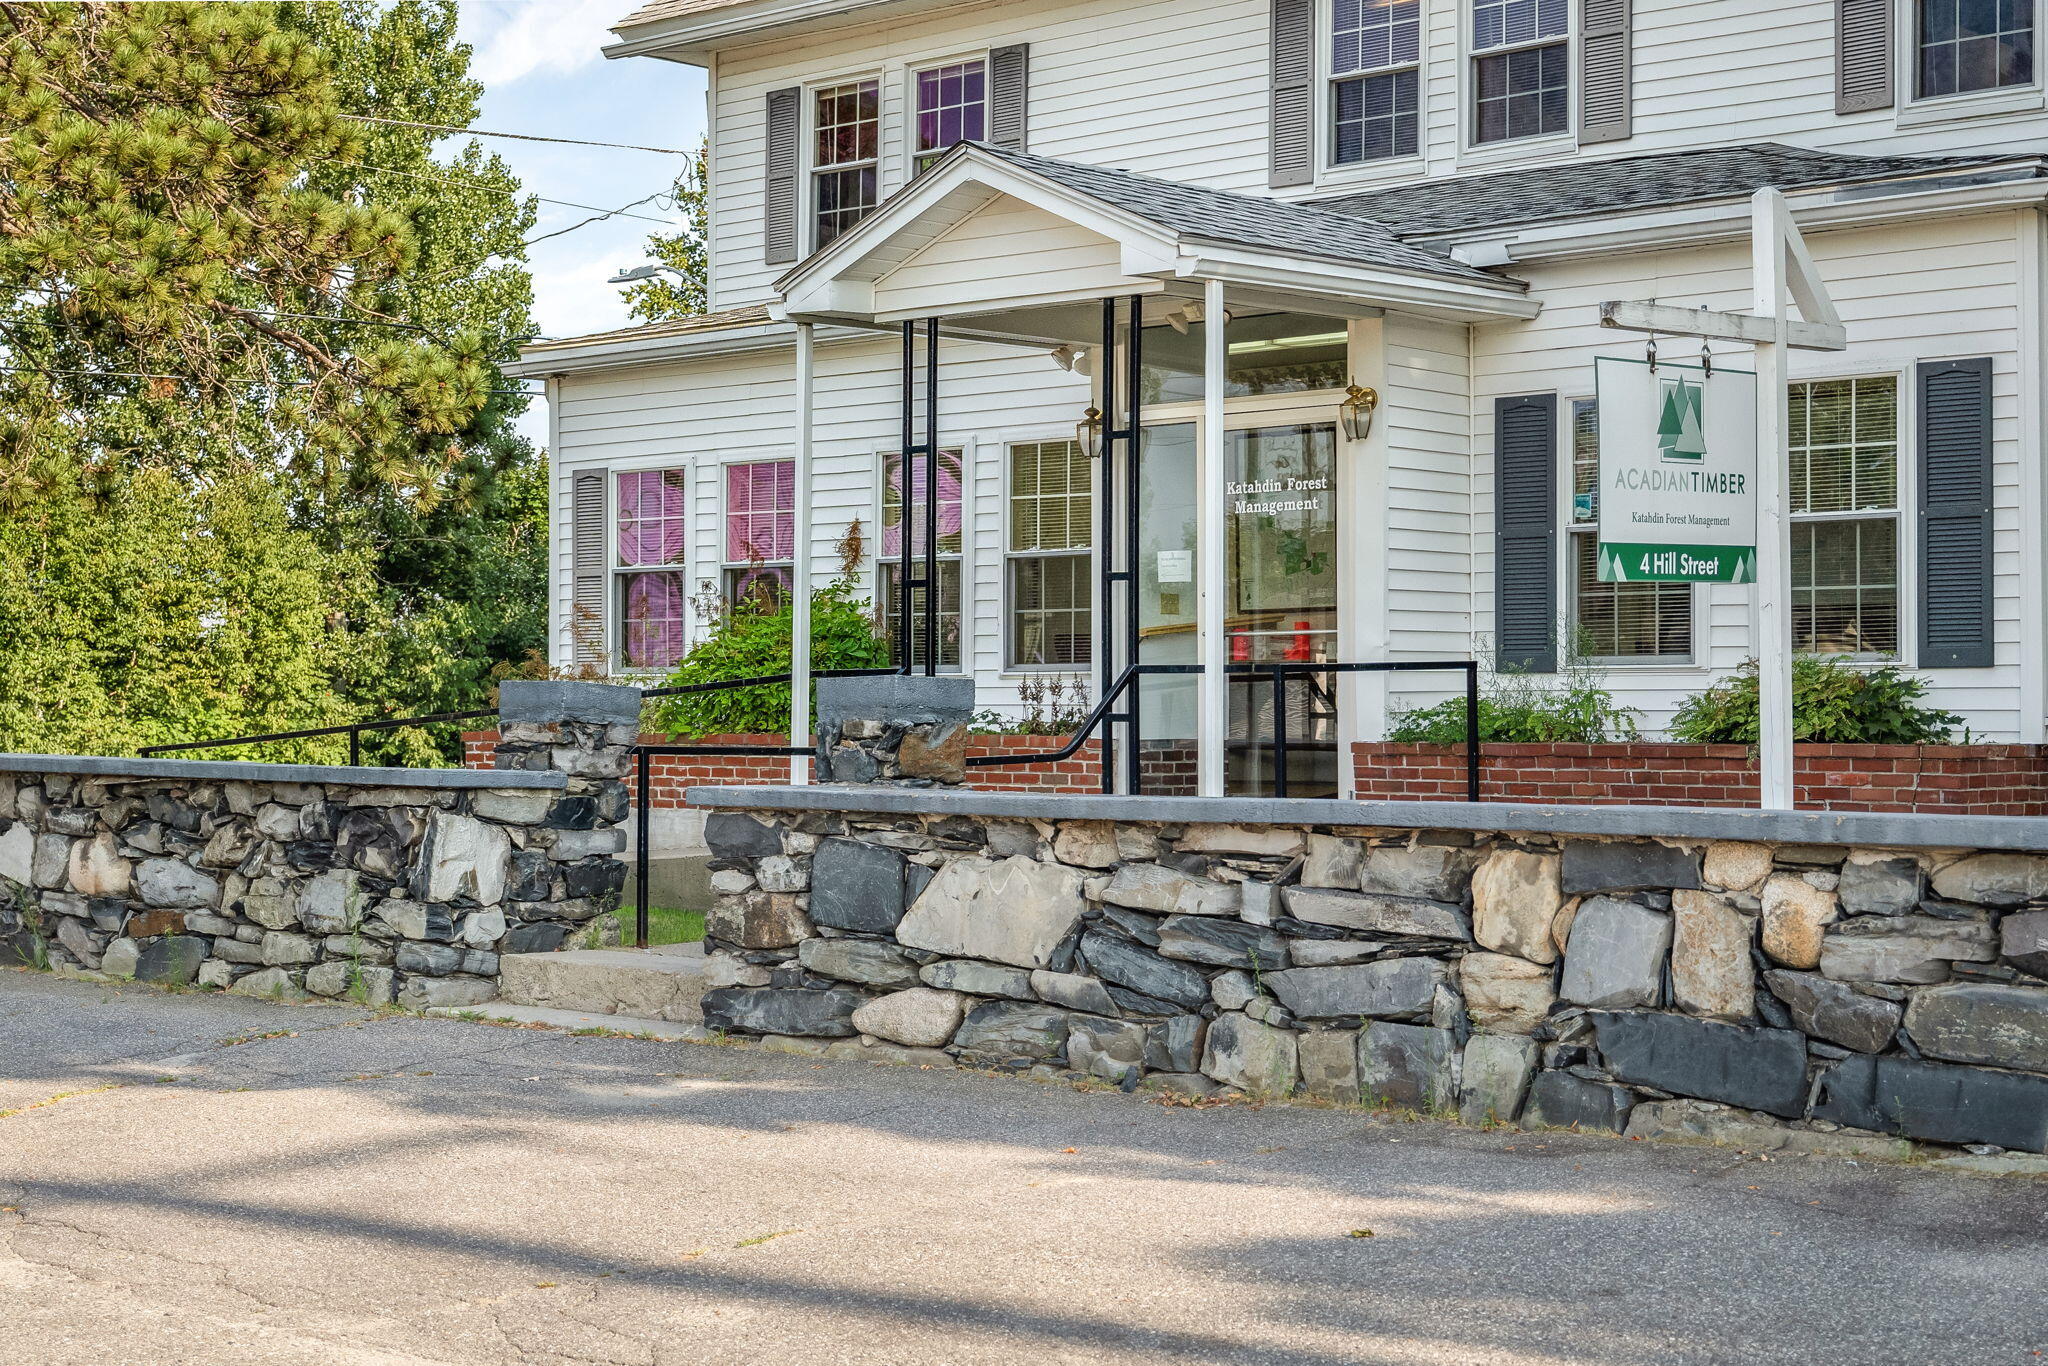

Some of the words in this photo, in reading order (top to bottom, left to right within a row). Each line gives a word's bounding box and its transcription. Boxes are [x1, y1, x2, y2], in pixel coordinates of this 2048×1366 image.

[1226, 478, 1282, 495] Katahdin
[1287, 475, 1327, 491] Forest
[1235, 497, 1318, 515] Management
[1632, 511, 1664, 524] Katahdin
[1666, 513, 1687, 525] Forest
[1688, 514, 1730, 528] Management
[1639, 552, 1650, 574] 4
[1653, 552, 1676, 575] Hill
[1680, 554, 1719, 575] Street
